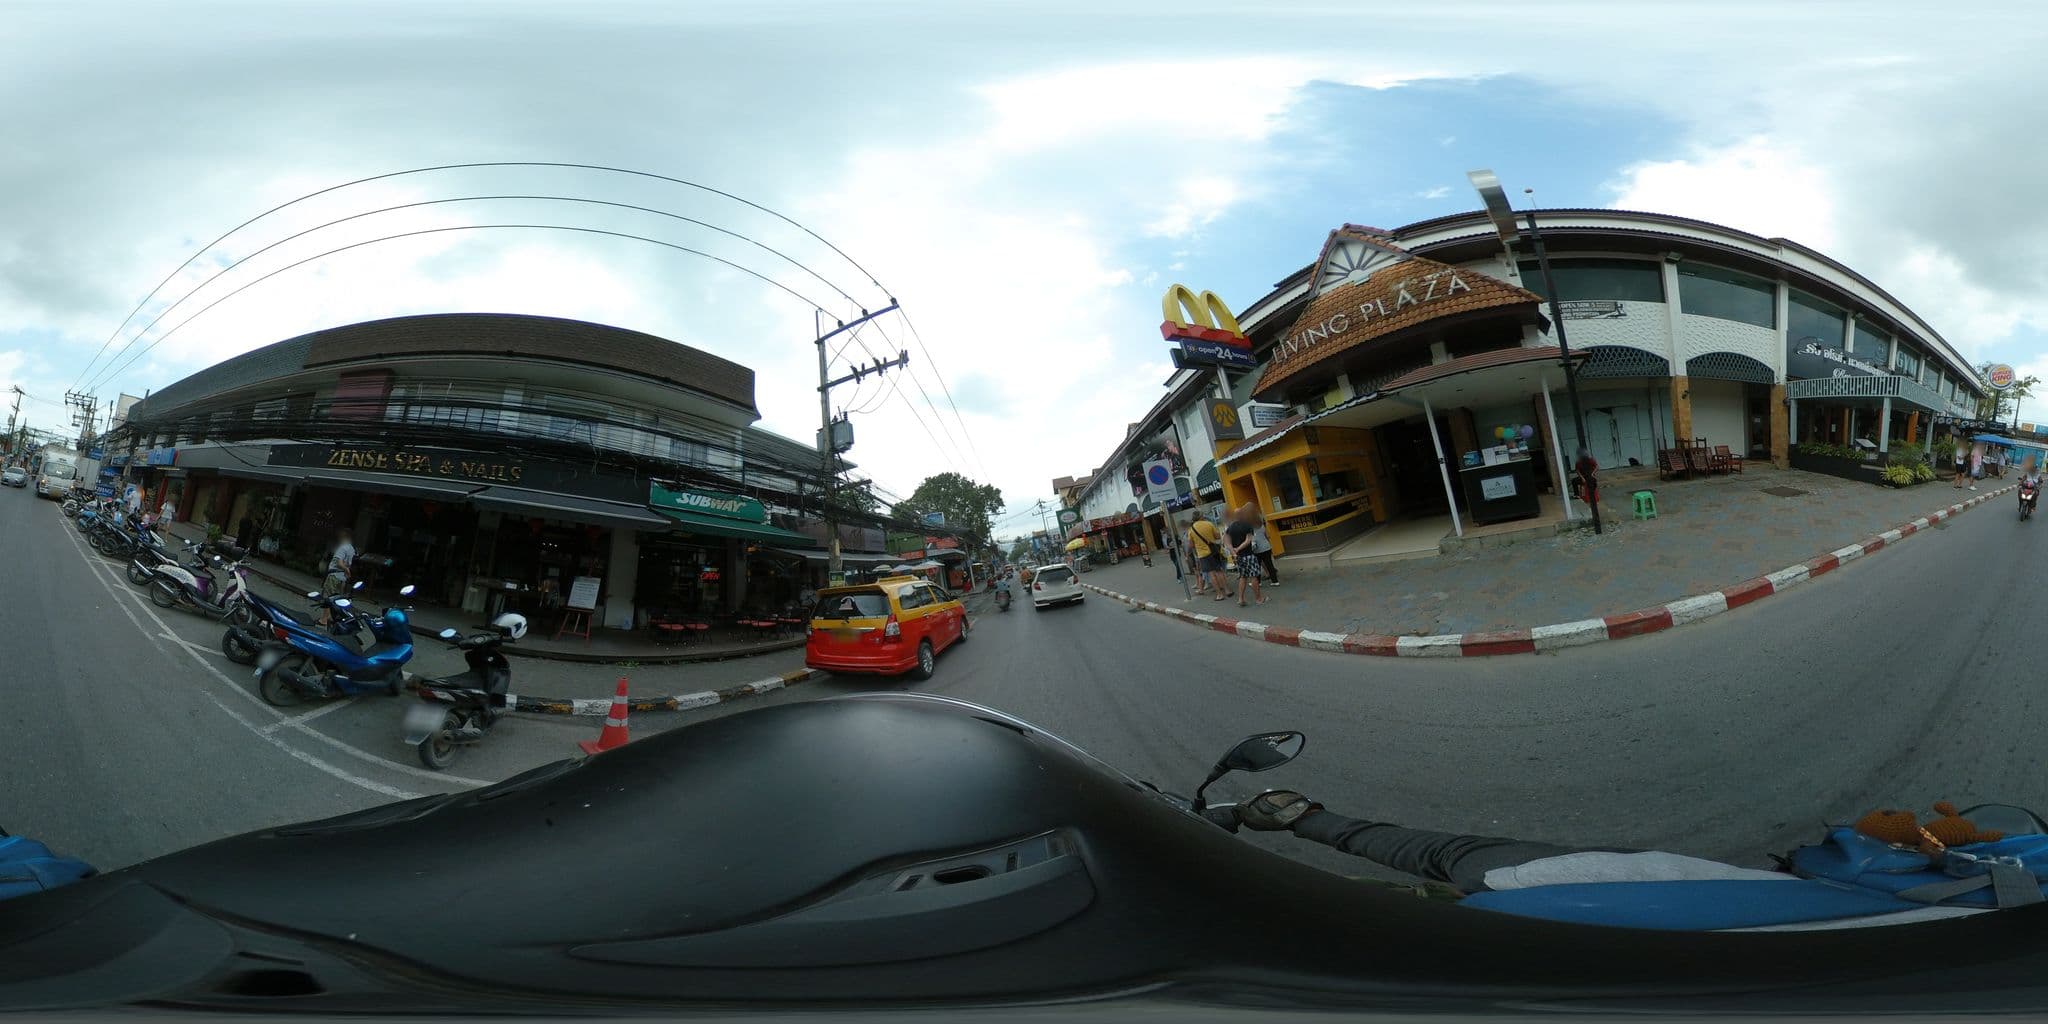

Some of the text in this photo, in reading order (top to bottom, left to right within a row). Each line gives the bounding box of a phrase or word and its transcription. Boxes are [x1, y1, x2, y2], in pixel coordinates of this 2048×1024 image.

[1271, 313, 1349, 364] LIVING
[1359, 274, 1472, 322] PLAZA
[1215, 346, 1233, 360] 24
[327, 449, 389, 469] ZENSE
[394, 451, 433, 473] SPA
[461, 461, 522, 482] NAILS
[676, 493, 747, 512] SUBWAY
